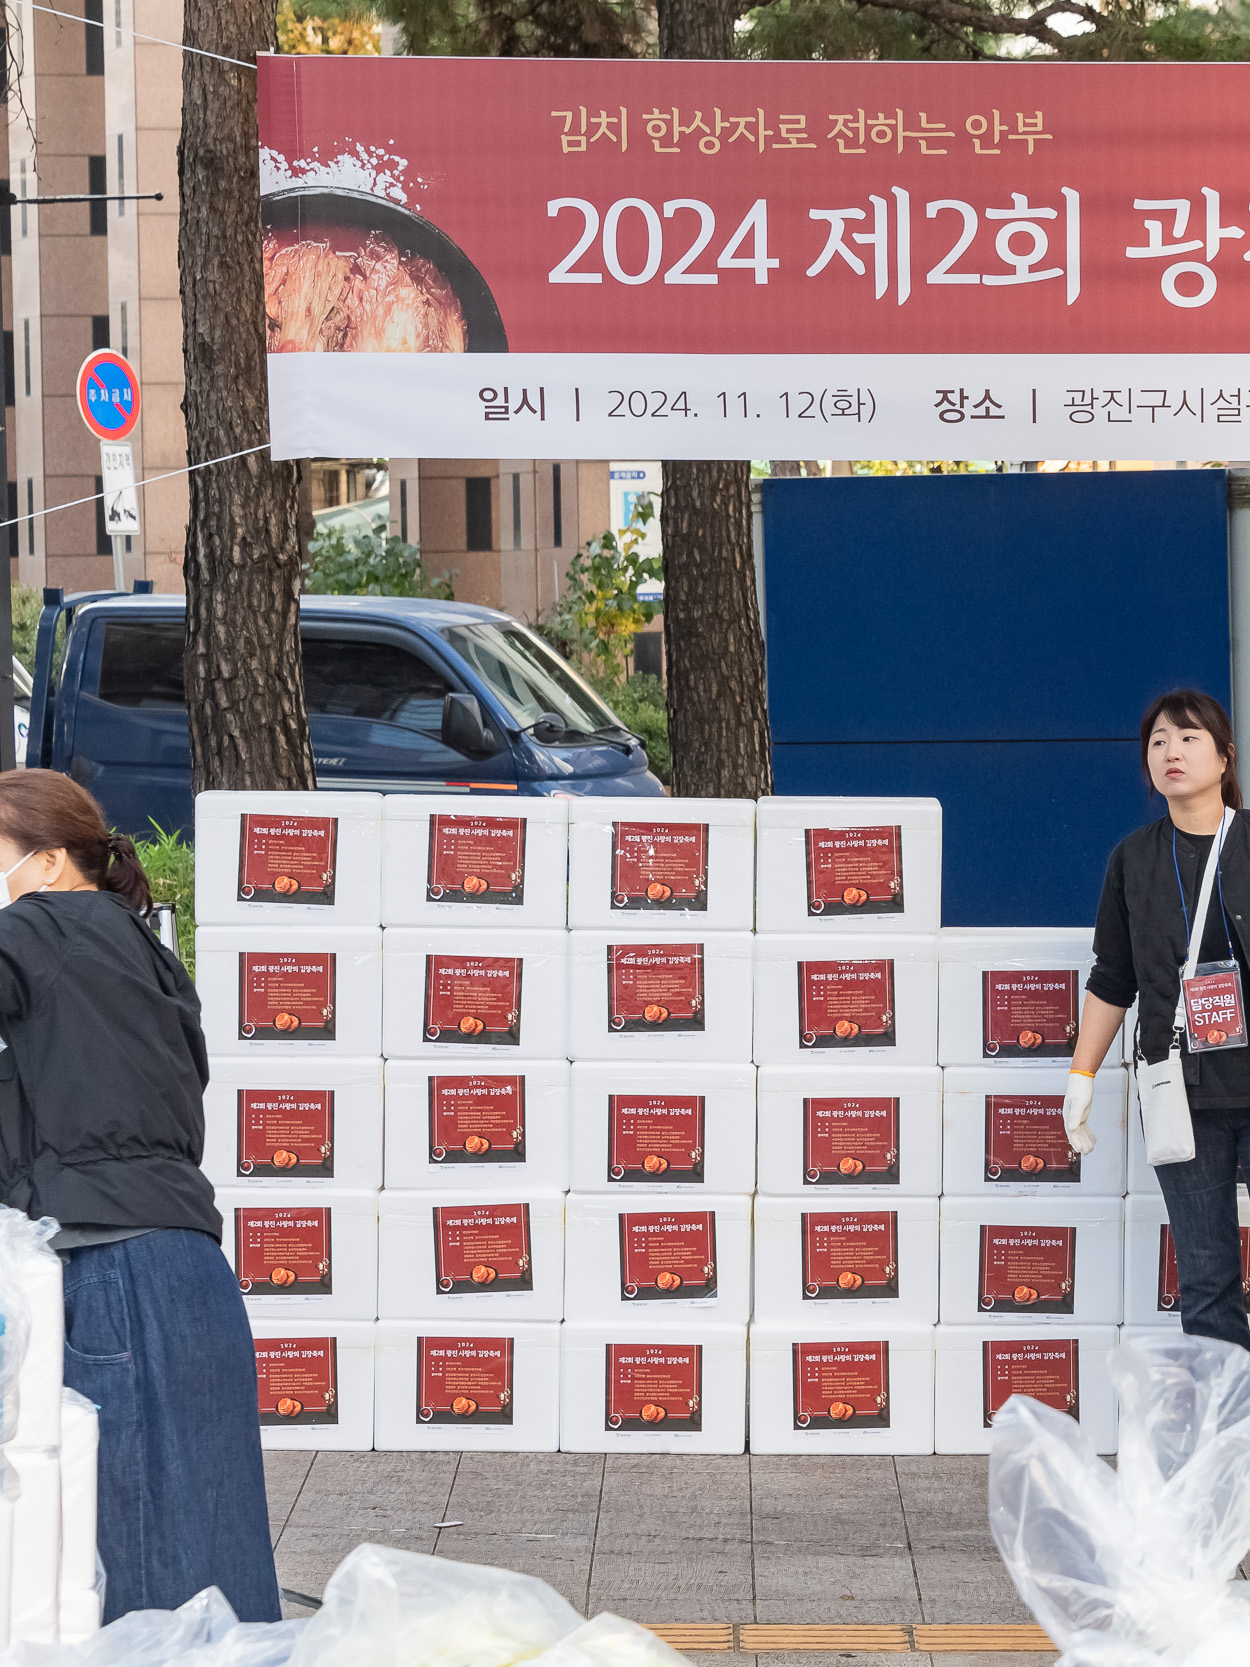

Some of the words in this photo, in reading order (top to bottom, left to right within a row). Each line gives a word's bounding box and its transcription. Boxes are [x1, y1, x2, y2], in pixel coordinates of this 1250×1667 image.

[551, 106, 627, 153] 김치
[642, 107, 817, 154] 한상자로
[827, 108, 955, 154] 전하는
[966, 109, 1052, 155] 안부
[547, 198, 779, 285] 2024
[806, 186, 1080, 305] 제2회
[479, 387, 546, 422] 일시
[607, 390, 698, 418] 2024.
[716, 391, 761, 419] 11.
[779, 388, 876, 424] 12(화)
[933, 387, 1006, 423] 장소
[471, 828, 488, 836] 사랑의
[490, 829, 513, 837] 김장축제
[818, 840, 833, 848] 제2회
[834, 840, 845, 848] 광진
[846, 839, 864, 847] 사랑의
[865, 838, 888, 846] 김장축제
[281, 965, 298, 973] 사랑의
[439, 967, 453, 975] 제2회
[454, 968, 466, 976] 광진
[467, 969, 484, 977] 사랑의
[486, 969, 509, 977] 김장축제
[827, 973, 838, 981] 광진
[839, 972, 856, 980] 사랑의
[858, 972, 880, 980] 김장축제
[1011, 983, 1022, 991] 광진
[1190, 994, 1235, 1011] 담당직원
[1194, 1009, 1236, 1026] STAFF
[266, 1102, 278, 1110] 광진
[279, 1102, 296, 1110] 사랑의
[298, 1102, 321, 1110] 김장축제
[637, 1107, 648, 1115] 광진
[263, 1220, 275, 1228] 광진
[276, 1220, 293, 1228] 사랑의
[462, 1218, 474, 1226] 광진
[475, 1217, 492, 1225] 사랑의
[493, 1216, 516, 1224] 김장축제
[660, 1224, 678, 1232] 사랑의
[679, 1223, 702, 1231] 김장축제
[843, 1224, 860, 1232] 사랑의
[1008, 1238, 1020, 1246] 광진
[1021, 1238, 1038, 1246] 사랑의
[446, 1349, 457, 1357] 광진
[821, 1354, 833, 1362] 광진
[834, 1354, 851, 1362] 사랑의
[853, 1353, 876, 1361] 김장축제
[1024, 1352, 1041, 1360] 사랑의
[635, 1356, 646, 1364] 광진
